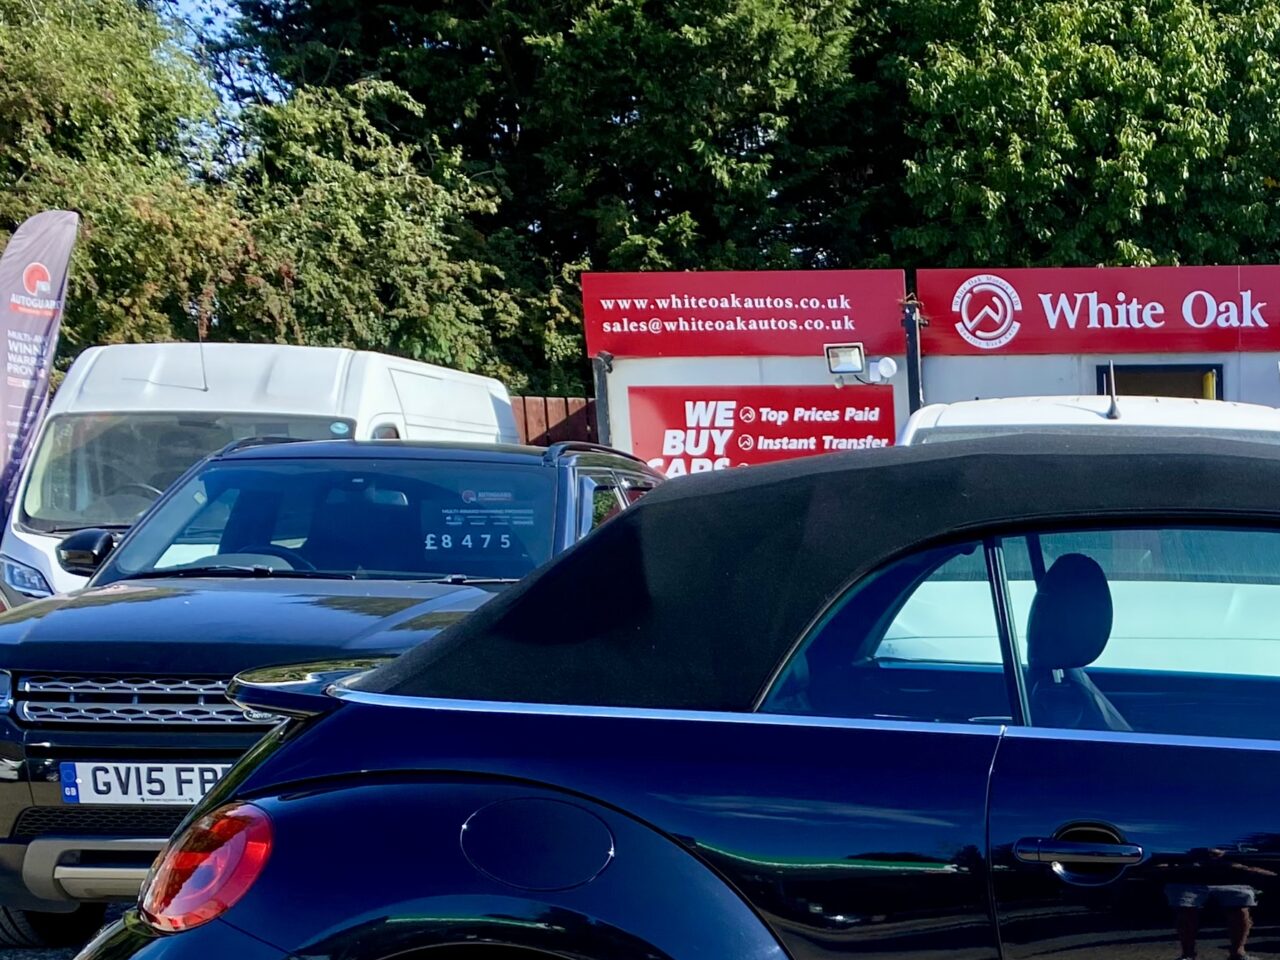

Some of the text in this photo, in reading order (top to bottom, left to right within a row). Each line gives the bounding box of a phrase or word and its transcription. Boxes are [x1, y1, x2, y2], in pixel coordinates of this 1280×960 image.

[600, 293, 852, 310] www.whiteoakautos.co.uk
[1038, 290, 1166, 329] White
[1181, 289, 1269, 329] Oak
[602, 315, 856, 334] sales@whiteoakautos.co.uk
[684, 400, 737, 428] WE
[759, 407, 880, 426] Top Prices Paid
[662, 429, 734, 456] BUY
[757, 434, 889, 450] Instant Transfer
[424, 533, 511, 550] £8475
[91, 766, 231, 796] GV15 FP
